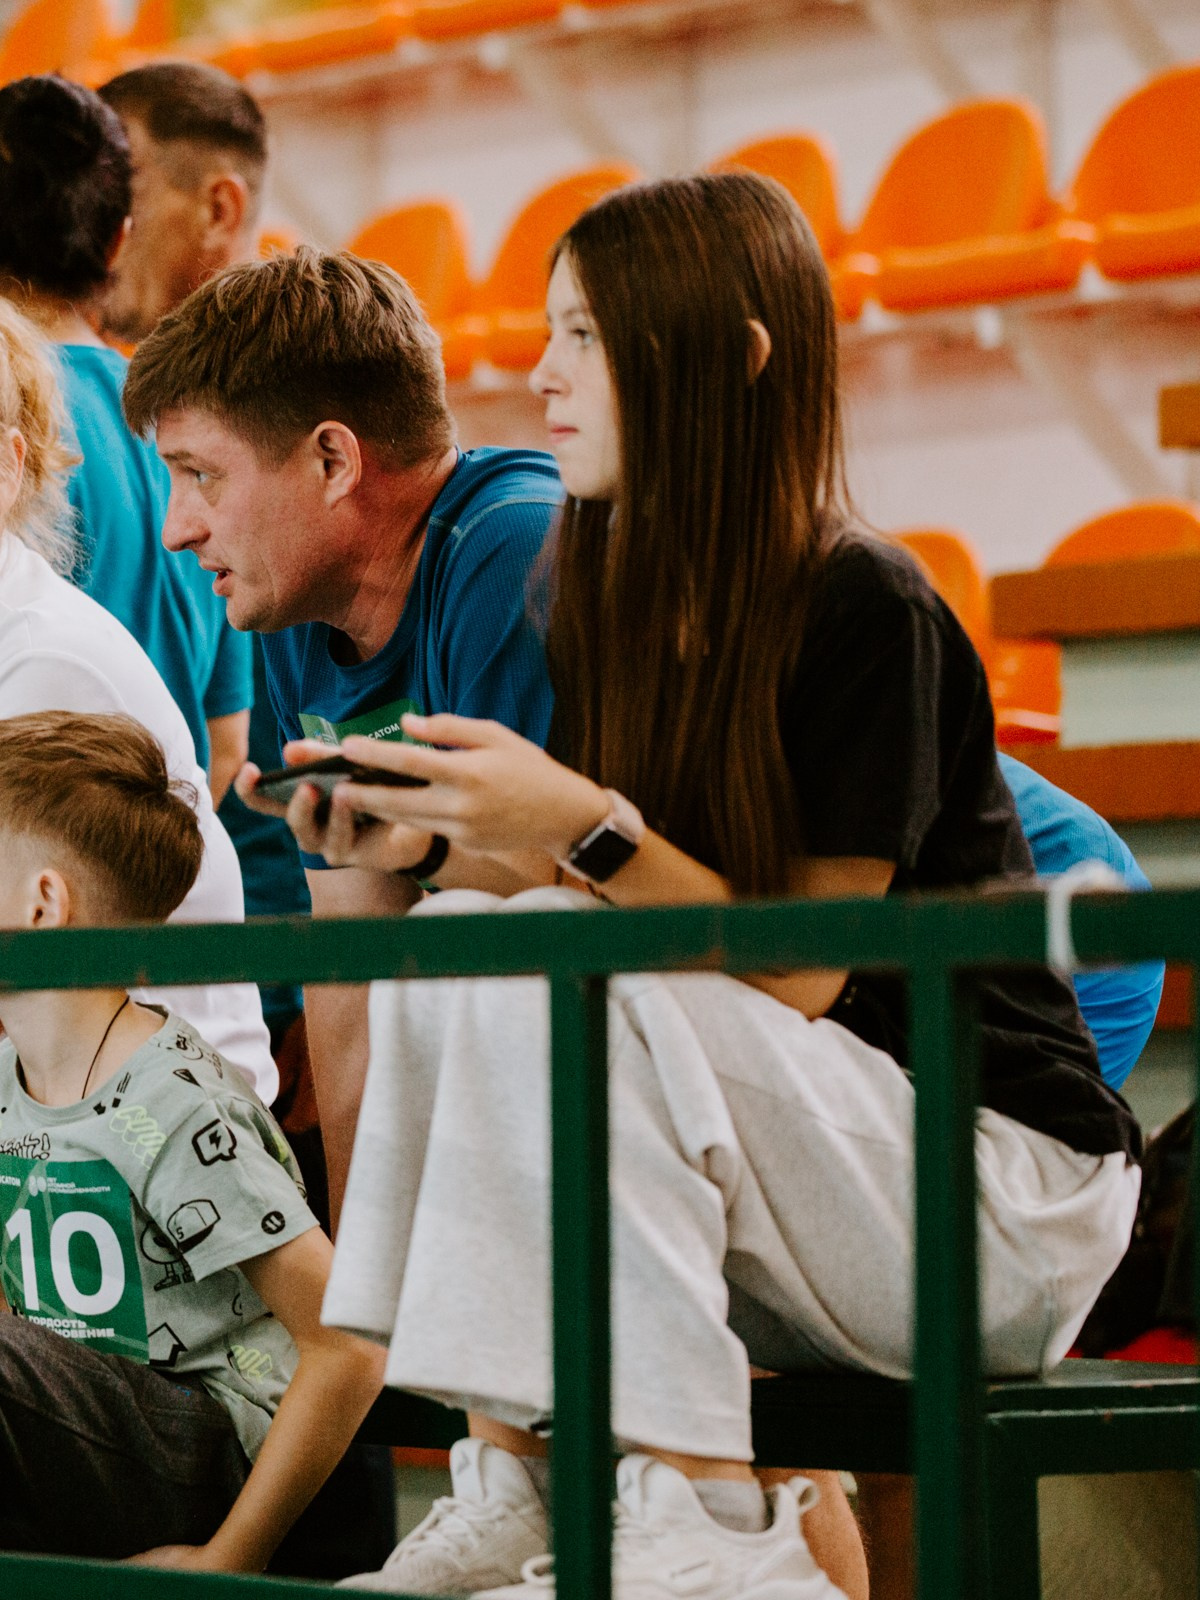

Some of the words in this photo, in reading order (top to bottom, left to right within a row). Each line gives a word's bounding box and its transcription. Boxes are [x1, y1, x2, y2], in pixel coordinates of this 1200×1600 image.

[366, 723, 400, 741] САТОМ
[5, 1207, 126, 1316] 10
[28, 1315, 87, 1329] ГОРДОСТЬ
